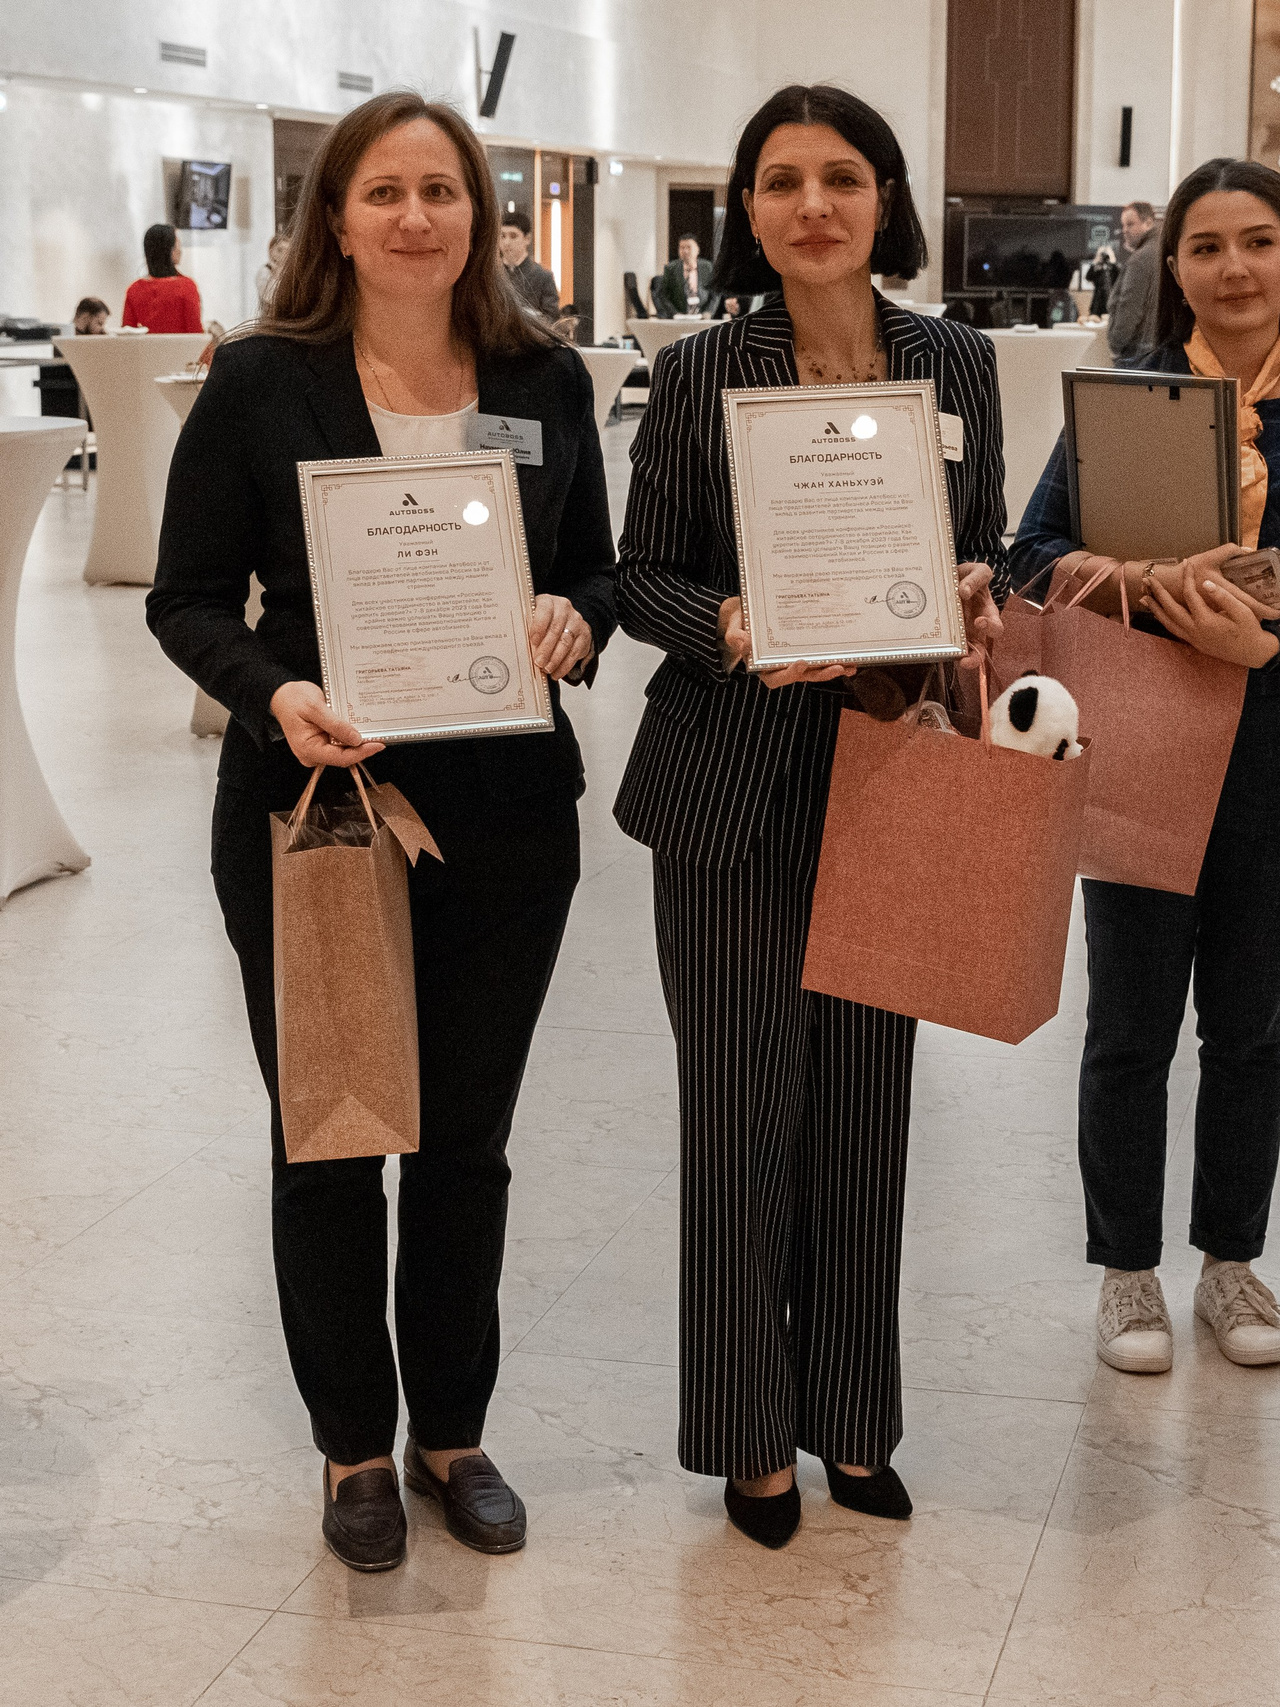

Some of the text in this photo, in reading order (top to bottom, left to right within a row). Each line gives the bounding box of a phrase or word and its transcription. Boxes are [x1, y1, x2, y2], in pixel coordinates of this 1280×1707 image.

[487, 431, 524, 440] AUTOBOSS
[790, 451, 882, 464] БЛАГОДАРНОСТЬ
[389, 508, 435, 516] AUTOBOSS
[367, 522, 462, 536] БЛАГОДАРНОСТЬ
[415, 549, 438, 557] ФЭН
